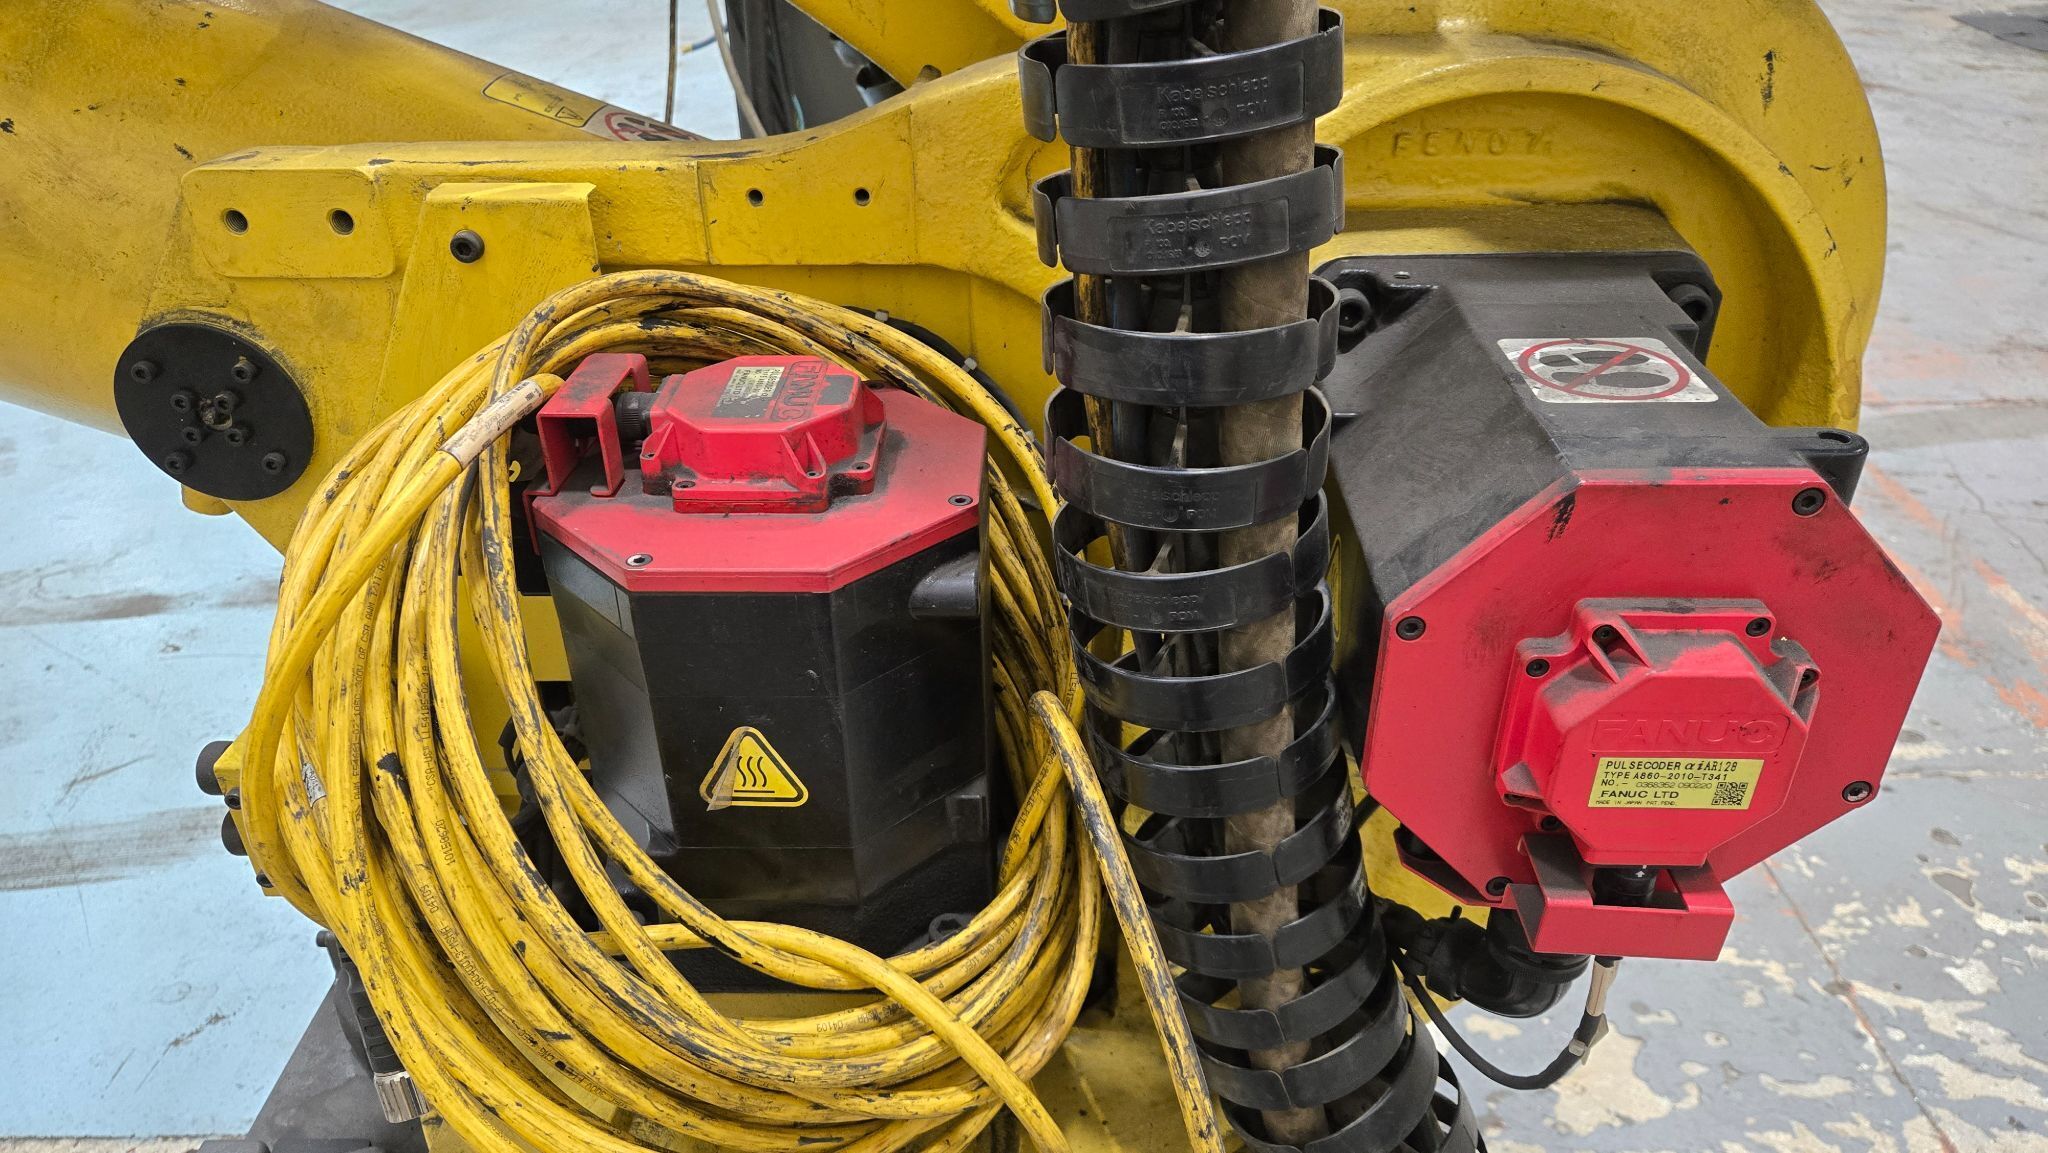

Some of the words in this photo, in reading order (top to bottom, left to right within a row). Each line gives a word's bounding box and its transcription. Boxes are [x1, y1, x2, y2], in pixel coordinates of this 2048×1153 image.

[364, 601, 375, 620] AWM
[360, 623, 370, 642] CSA
[1592, 718, 1779, 745] FANUC
[1605, 760, 1681, 771] PULSECODER
[1604, 771, 1631, 779] TYPE
[1633, 772, 1728, 781] A860-2010-T341
[1600, 790, 1649, 798] FANUC
[1653, 790, 1679, 799] LTD
